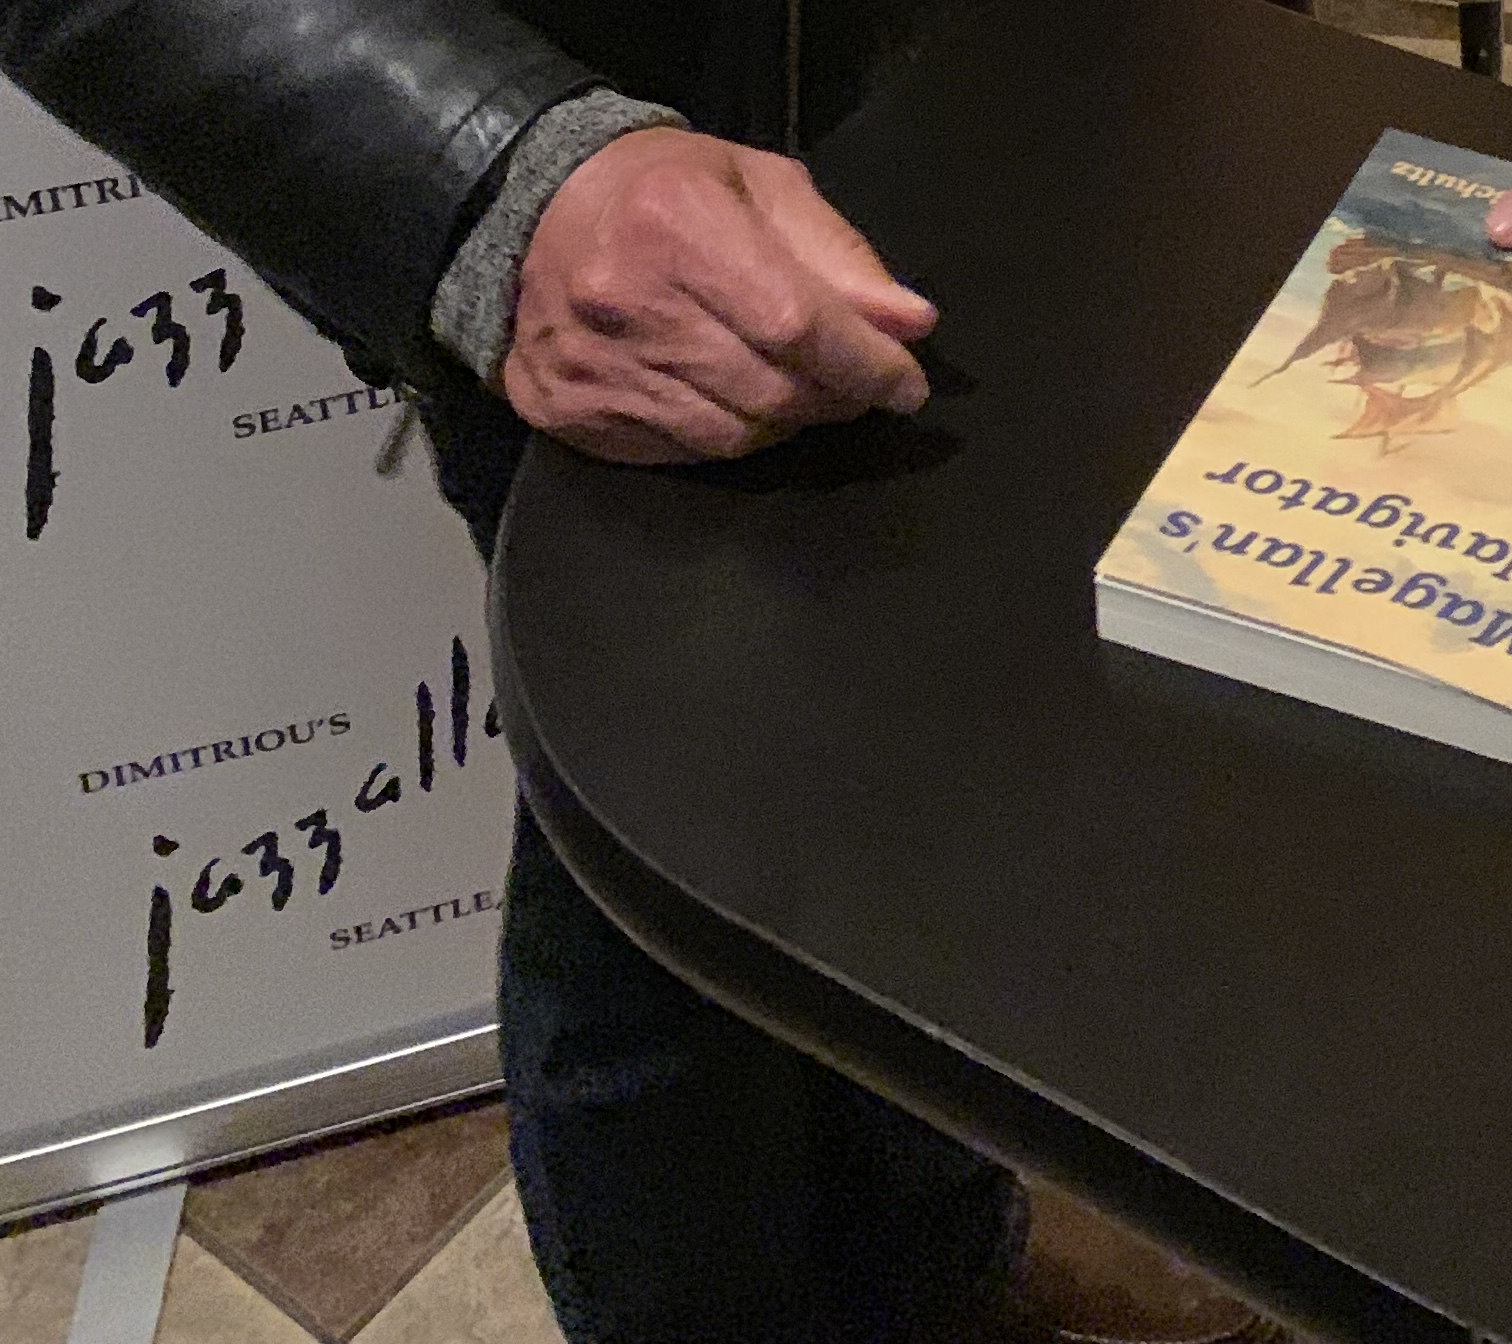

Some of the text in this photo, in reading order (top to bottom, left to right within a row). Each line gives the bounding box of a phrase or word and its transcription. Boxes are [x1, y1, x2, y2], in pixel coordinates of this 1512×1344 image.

[0, 173, 142, 222] MITRI
[25, 268, 246, 541] jazz
[232, 386, 403, 439] SEATTL
[78, 711, 351, 794] DIMITRIOU'S
[144, 809, 343, 1049] jazz
